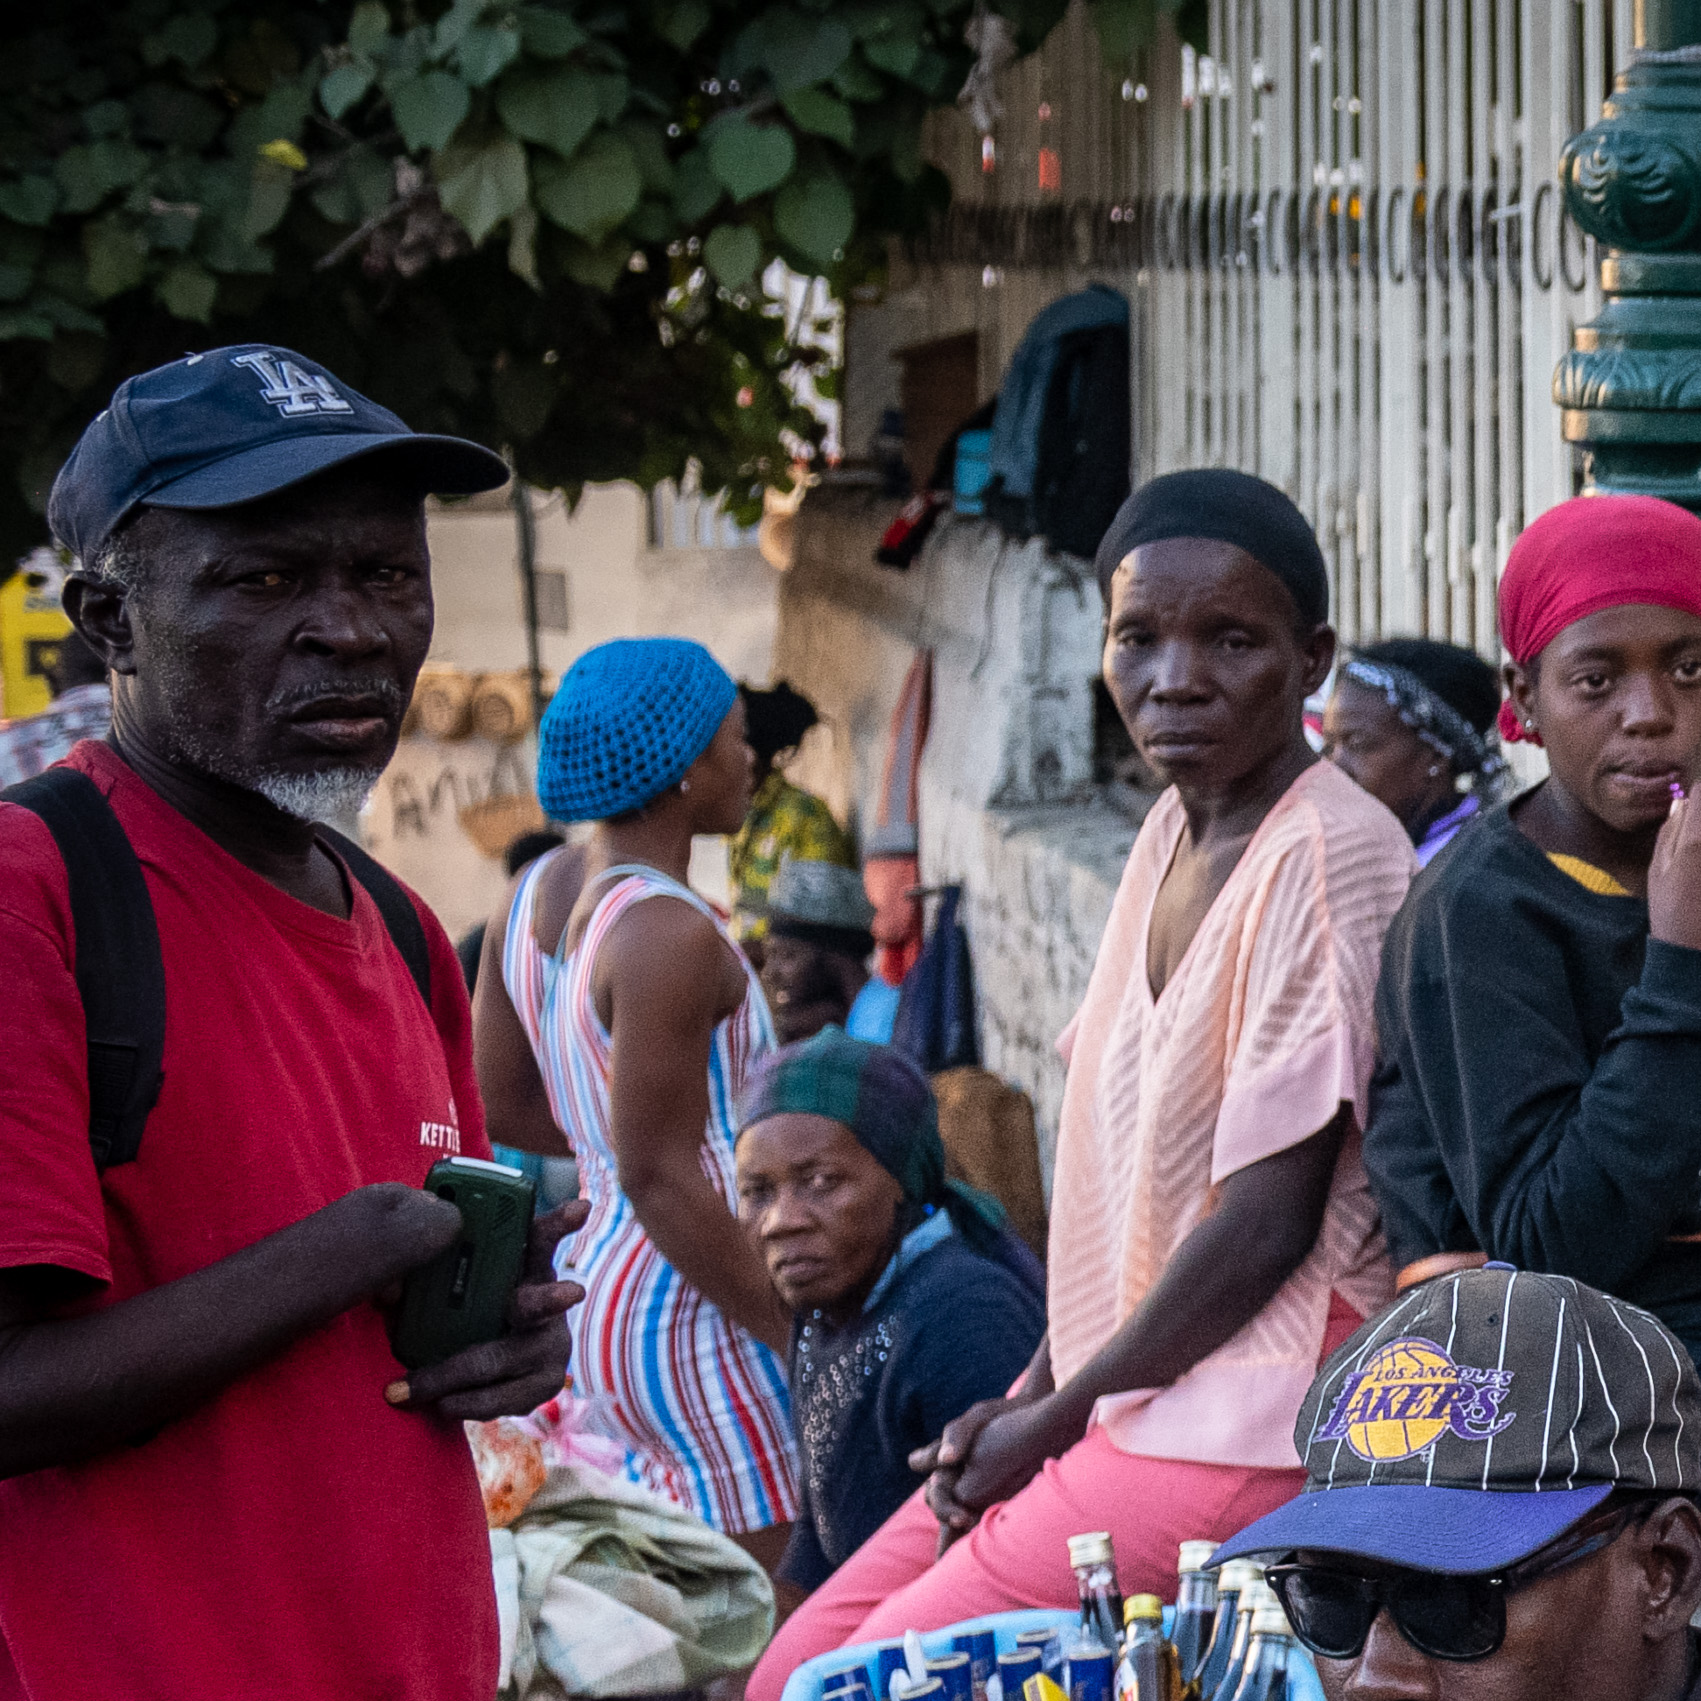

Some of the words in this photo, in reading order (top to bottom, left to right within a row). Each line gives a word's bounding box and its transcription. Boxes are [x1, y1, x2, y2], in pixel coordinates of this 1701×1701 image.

[231, 351, 354, 417] LA
[1312, 1371, 1517, 1442] LAKERS
[1374, 1367, 1405, 1383] LOS
[1411, 1365, 1515, 1386] ANGELES
